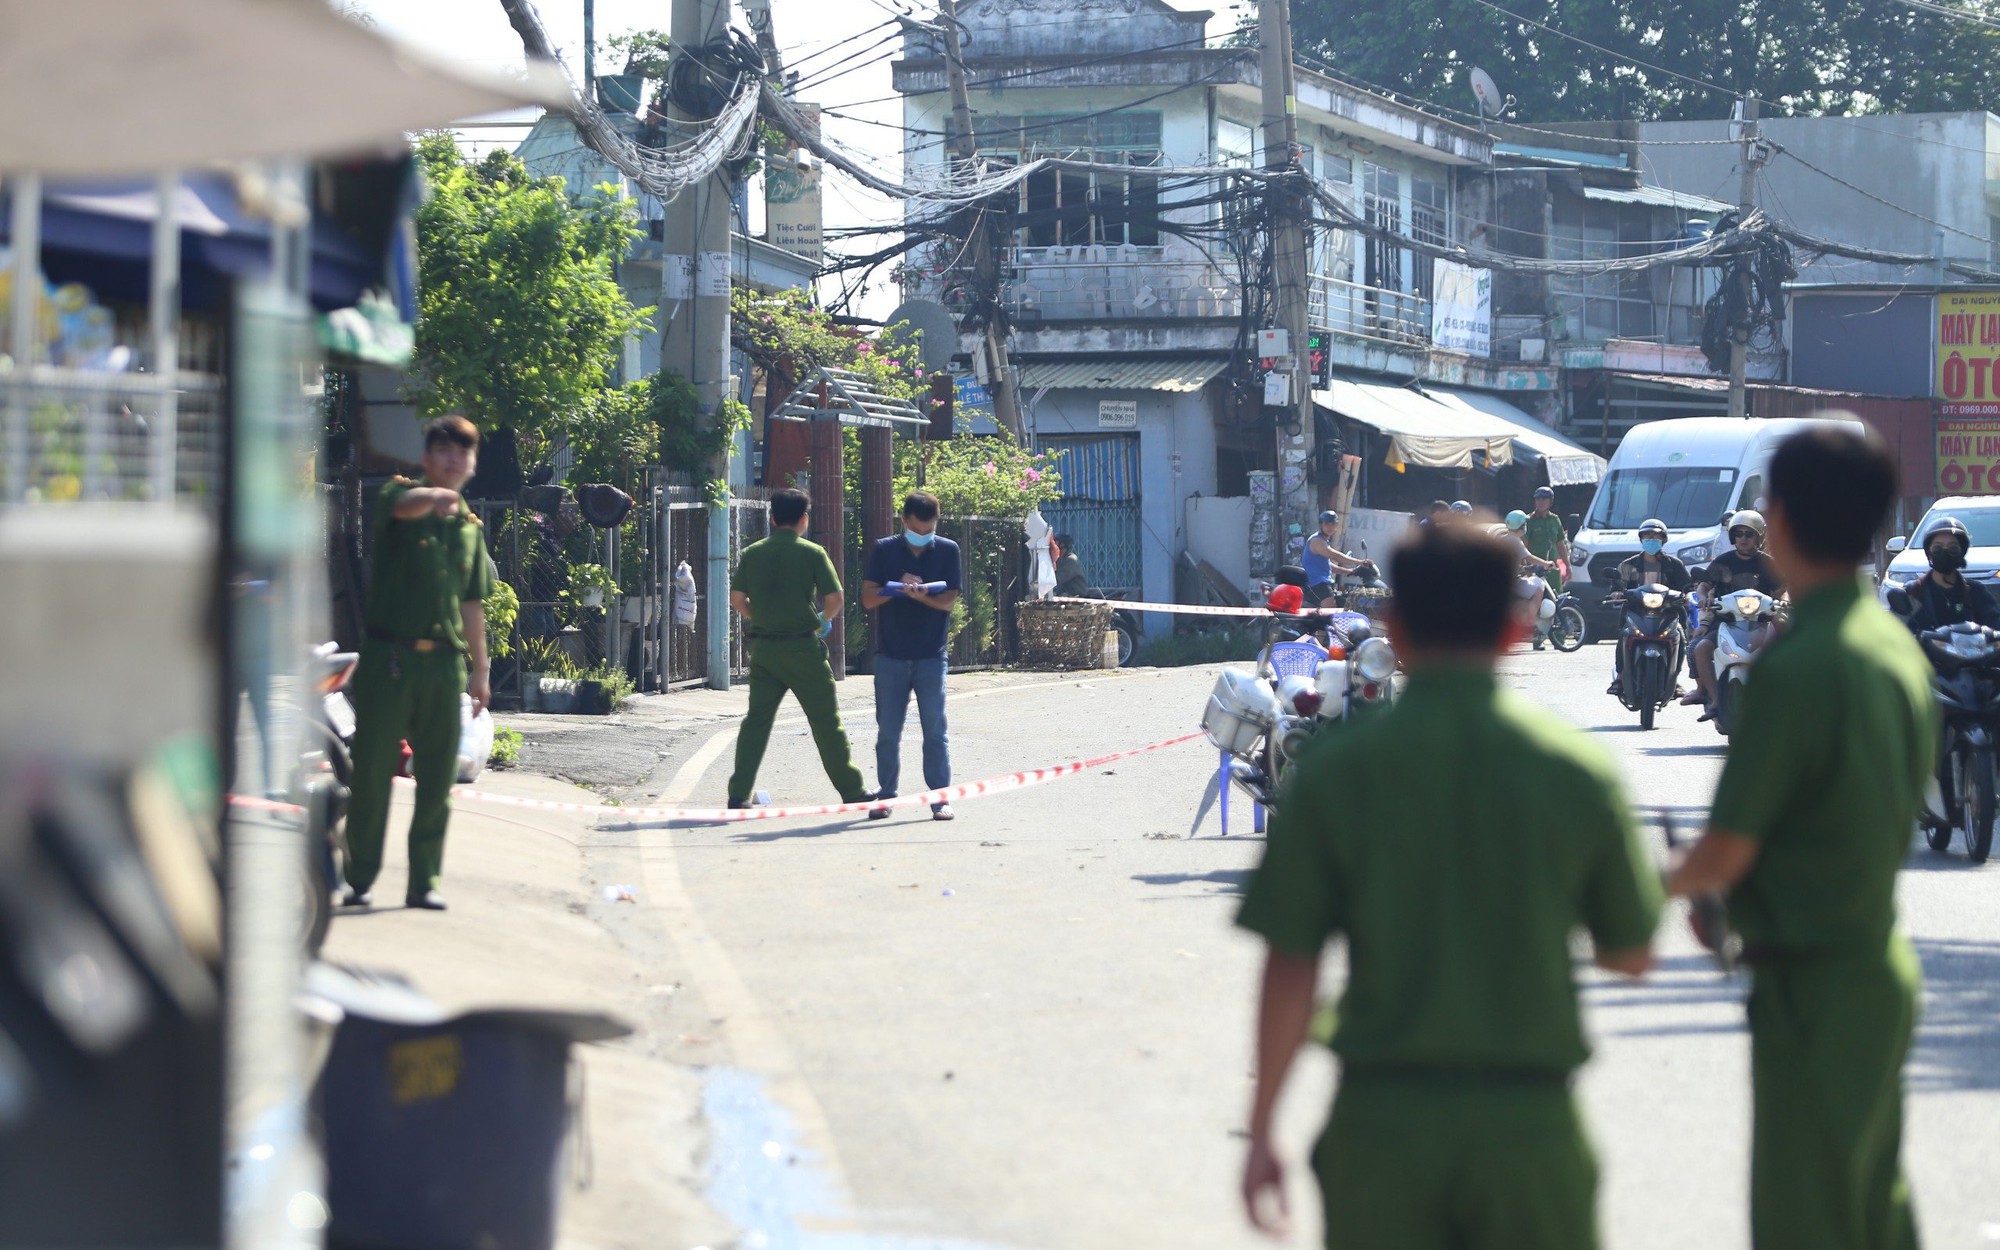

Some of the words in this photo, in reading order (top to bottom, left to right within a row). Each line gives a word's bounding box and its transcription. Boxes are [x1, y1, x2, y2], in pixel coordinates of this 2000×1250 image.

[776, 223, 794, 233] Tiệc
[797, 223, 816, 232] Cưới
[776, 236, 795, 244] Liên
